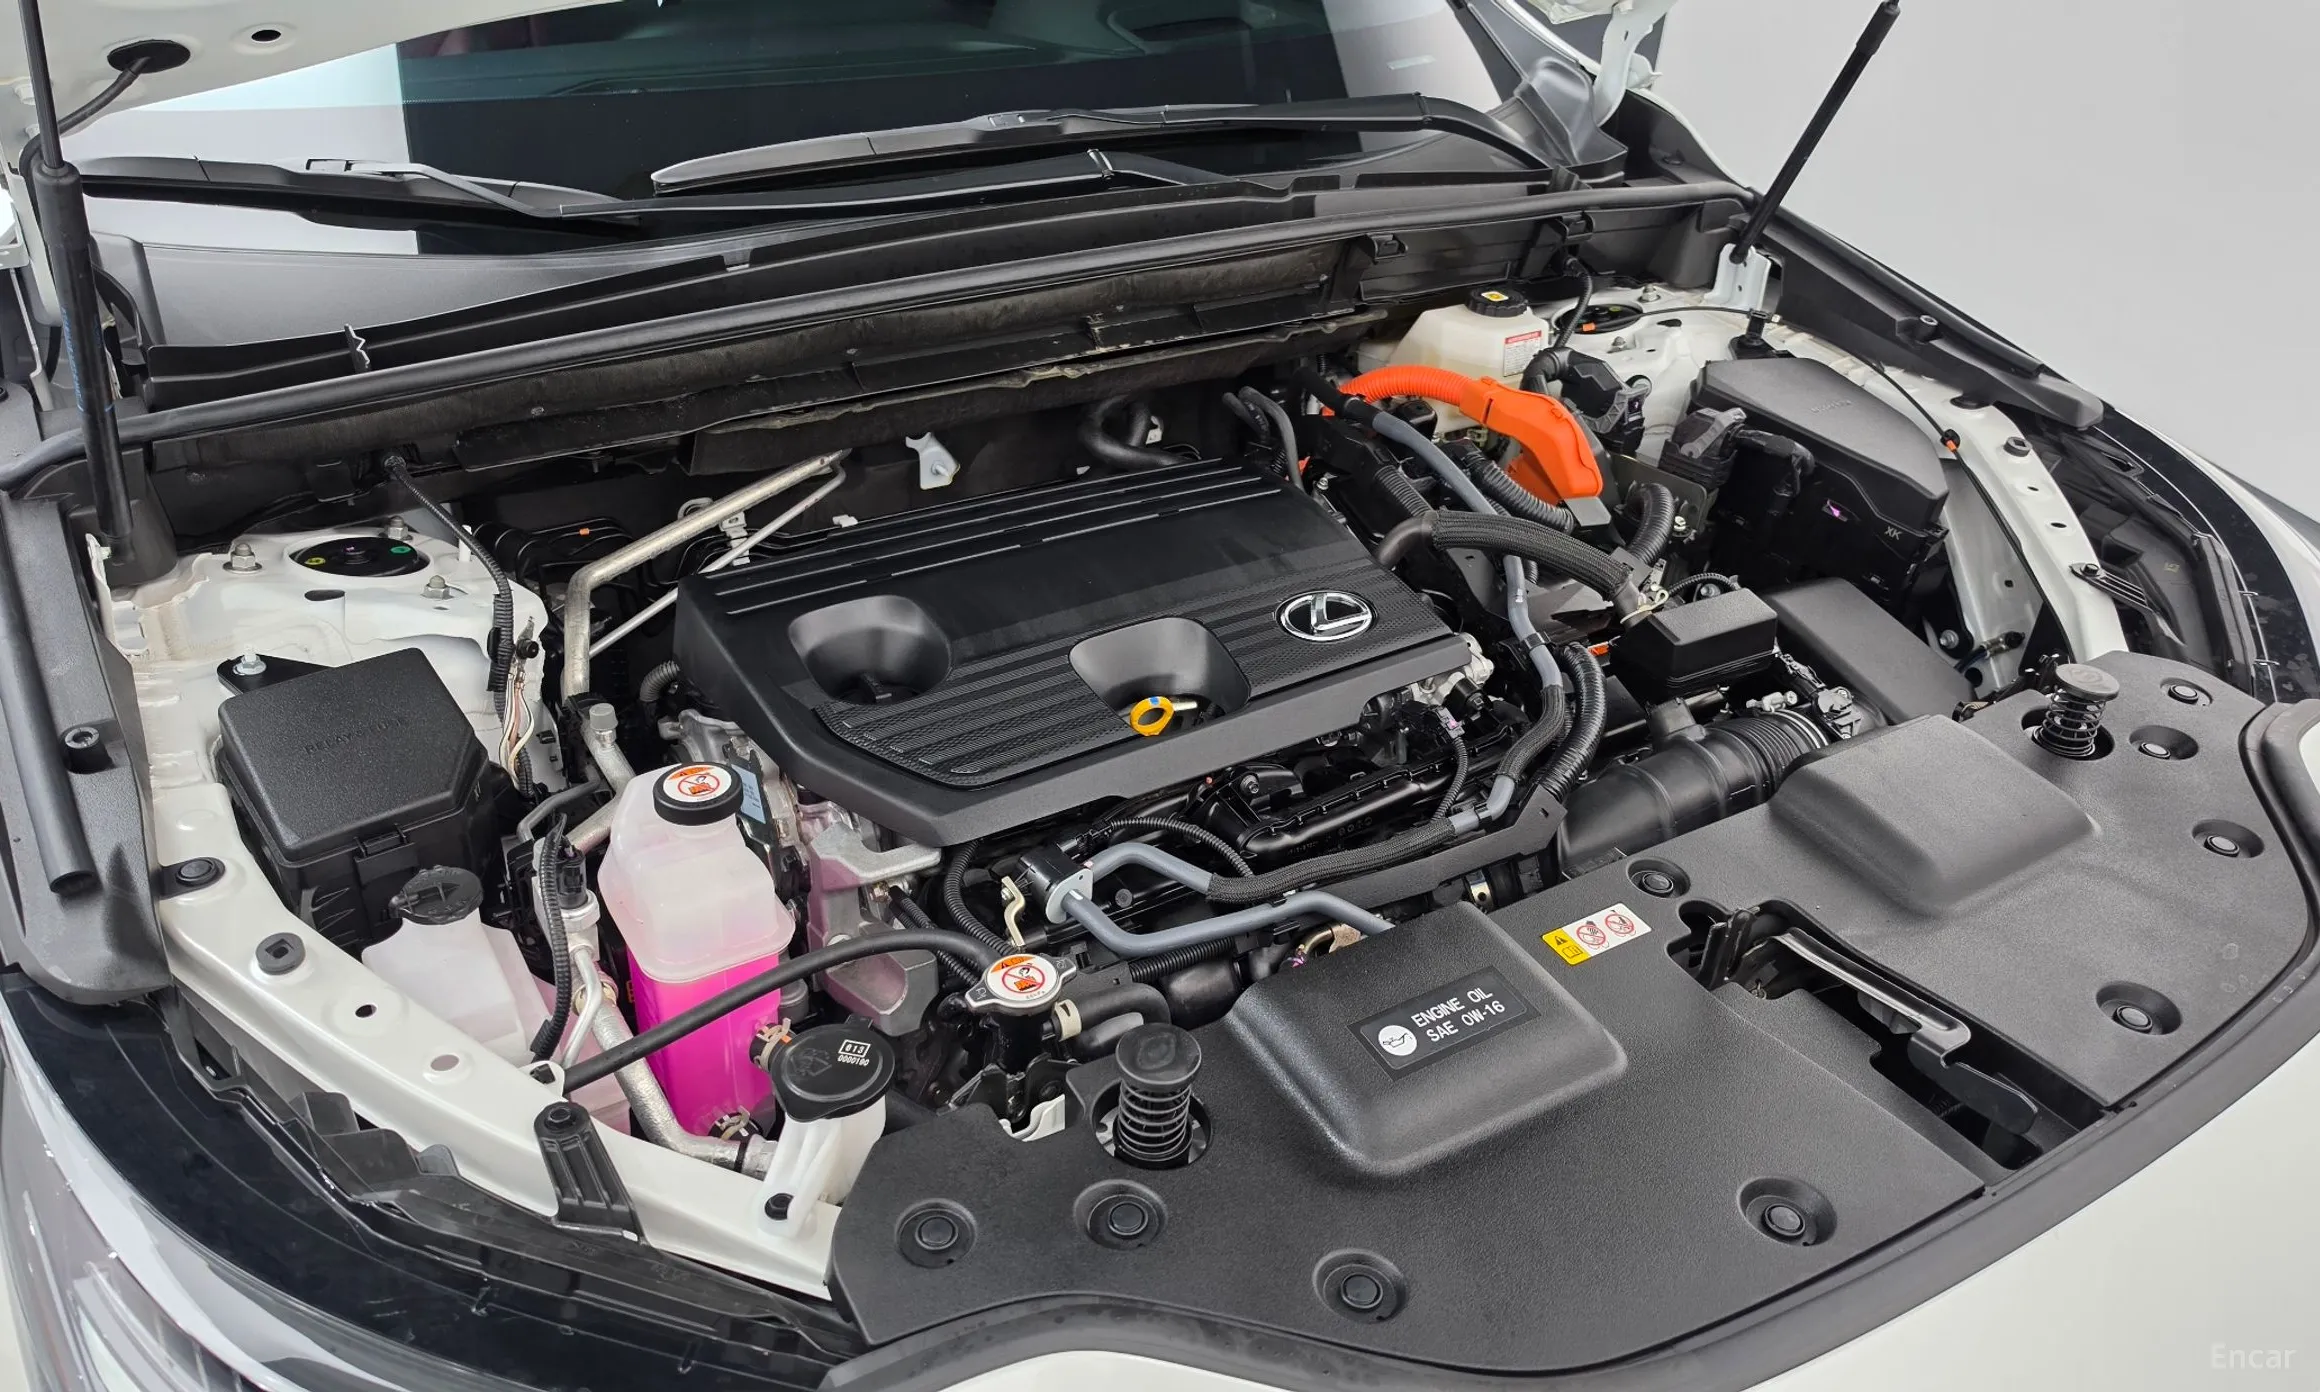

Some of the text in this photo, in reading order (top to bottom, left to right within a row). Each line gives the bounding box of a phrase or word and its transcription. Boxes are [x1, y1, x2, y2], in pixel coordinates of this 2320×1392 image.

[1884, 526, 1901, 540] XK
[1411, 987, 1493, 1028] ENGINE OIL
[1426, 1000, 1505, 1042] SAE 0W-16
